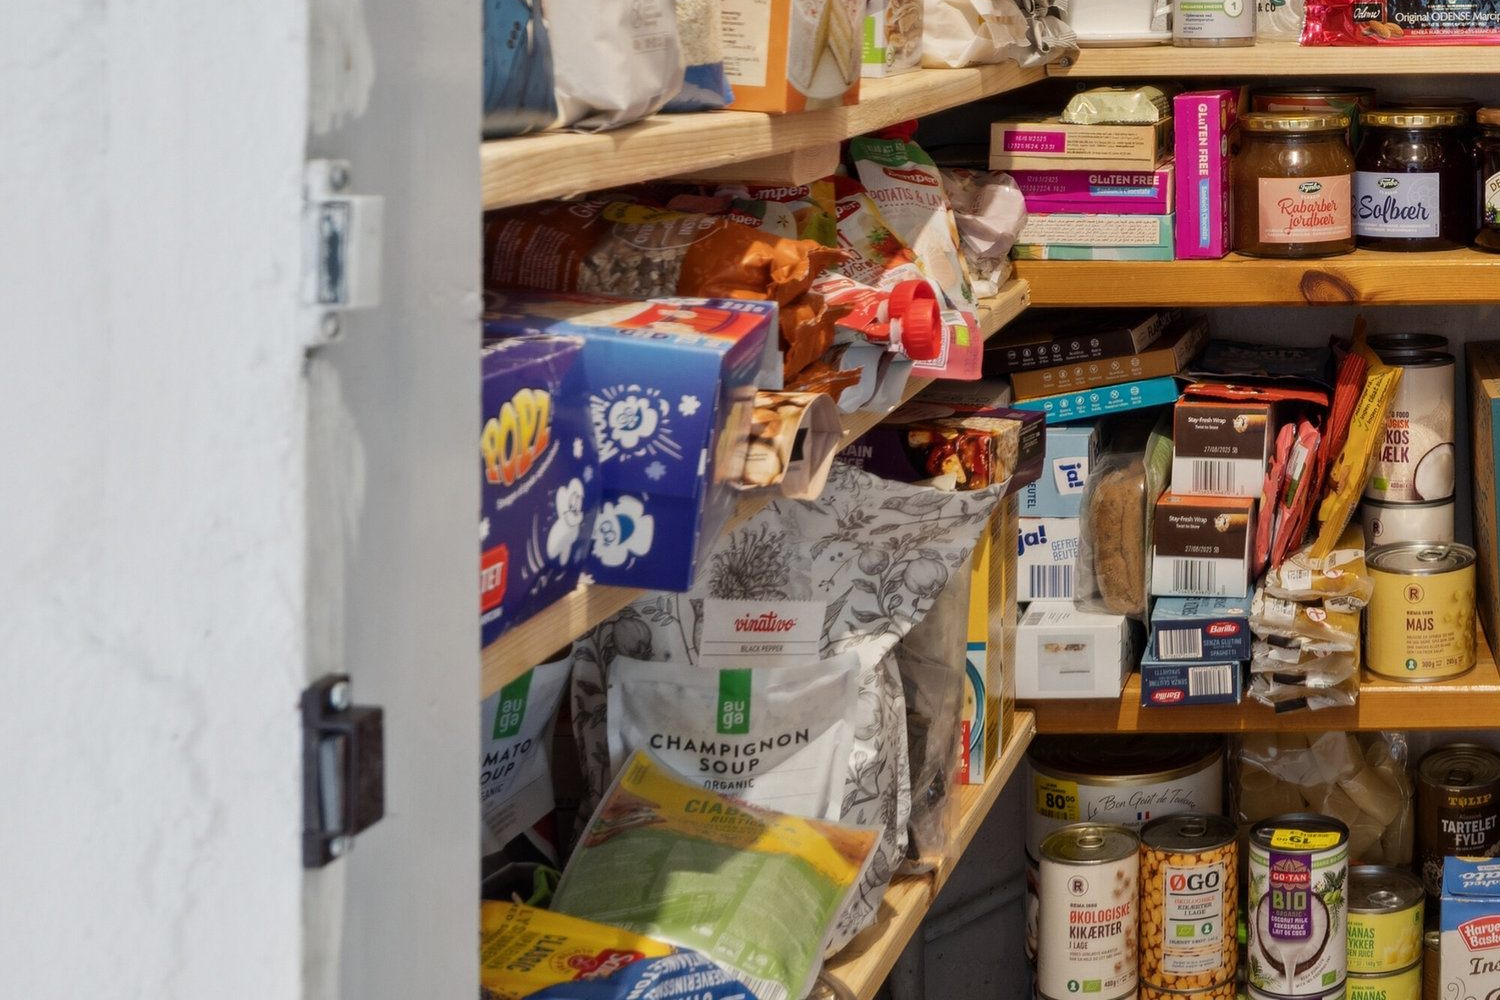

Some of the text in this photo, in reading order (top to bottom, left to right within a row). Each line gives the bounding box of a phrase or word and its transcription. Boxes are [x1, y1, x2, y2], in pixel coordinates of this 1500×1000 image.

[1394, 11, 1430, 24] Original
[1431, 11, 1471, 22] ODENSE
[1198, 148, 1209, 176] FREE
[1132, 176, 1160, 186] FREE
[870, 186, 924, 202] POTATIS &
[1277, 197, 1338, 215] Rabarber
[1358, 194, 1430, 223] Solbær
[1283, 211, 1336, 235] jordbær
[1212, 416, 1227, 425] Wrap
[1193, 515, 1208, 524] Wrap
[734, 610, 798, 634] vinativo
[1209, 624, 1237, 634] Barilla
[1406, 617, 1435, 631] MAJS
[760, 644, 784, 653] PEPPER
[1209, 649, 1237, 657] SPAGHETTI
[1153, 691, 1181, 701] Barilla
[650, 728, 810, 760] CHAMPIGNON
[699, 757, 761, 776] SOUP
[703, 778, 755, 790] ORGANIC
[1045, 793, 1067, 810] 80
[1099, 794, 1126, 811] Bon
[1447, 793, 1492, 808] TULIP
[1441, 814, 1497, 834] TARTELET
[1455, 831, 1486, 847] FYLD
[1169, 870, 1221, 892] ØGO
[1272, 889, 1308, 911] BIO
[1069, 902, 1131, 924] ØKOLOGISKE
[1069, 921, 1123, 940] KIKÆRTER
[1271, 928, 1284, 936] LAIT
[1273, 922, 1305, 930] KOKOSMELK
[1072, 941, 1088, 951] LAGE
[1357, 949, 1375, 958] JUICE
